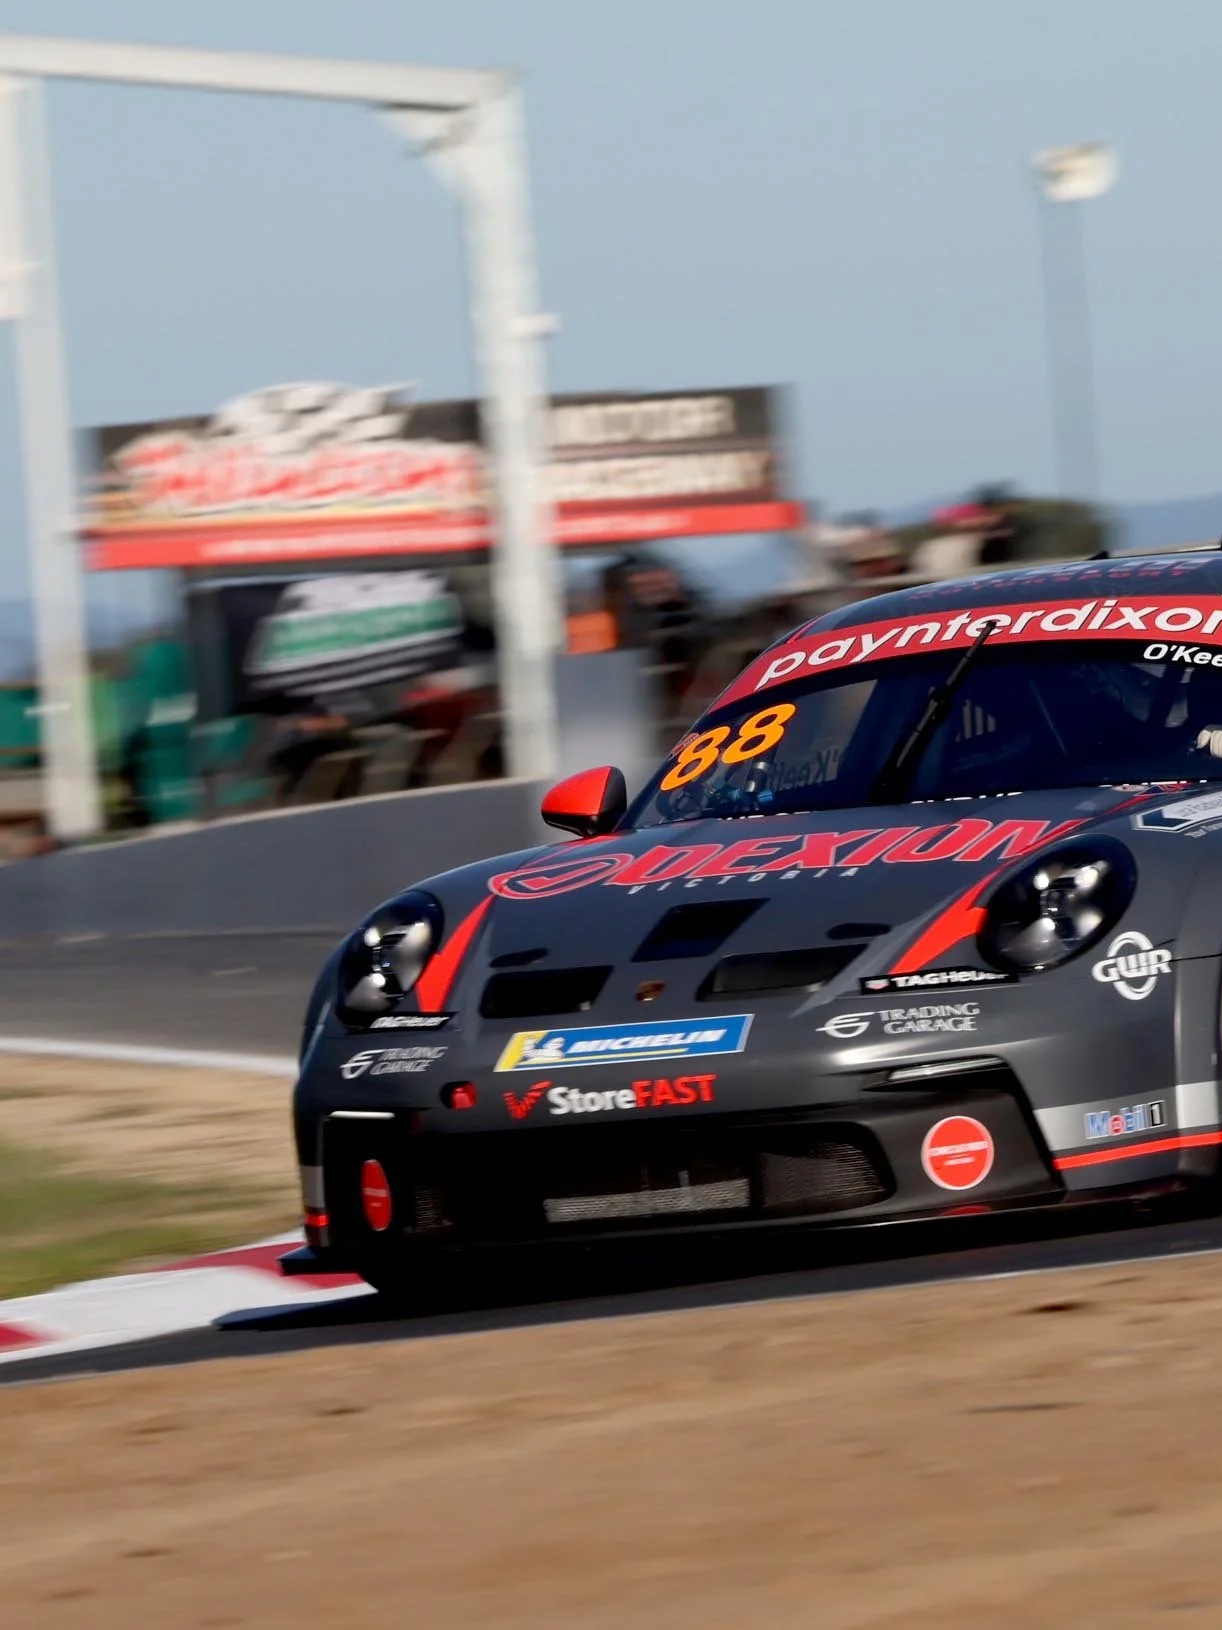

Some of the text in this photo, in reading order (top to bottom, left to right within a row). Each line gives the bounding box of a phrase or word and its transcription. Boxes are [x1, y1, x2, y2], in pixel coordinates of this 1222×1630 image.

[660, 703, 796, 791] 88
[601, 818, 1060, 886] DEXION
[627, 867, 859, 895] VICTORIA
[1092, 948, 1173, 983] GWR
[880, 1002, 980, 1021] TRADING
[883, 1016, 978, 1034] GARAGE
[568, 1029, 728, 1053] MICHELIN
[548, 1074, 717, 1115] StoreFAST
[1084, 1101, 1165, 1139] Mobil 1
